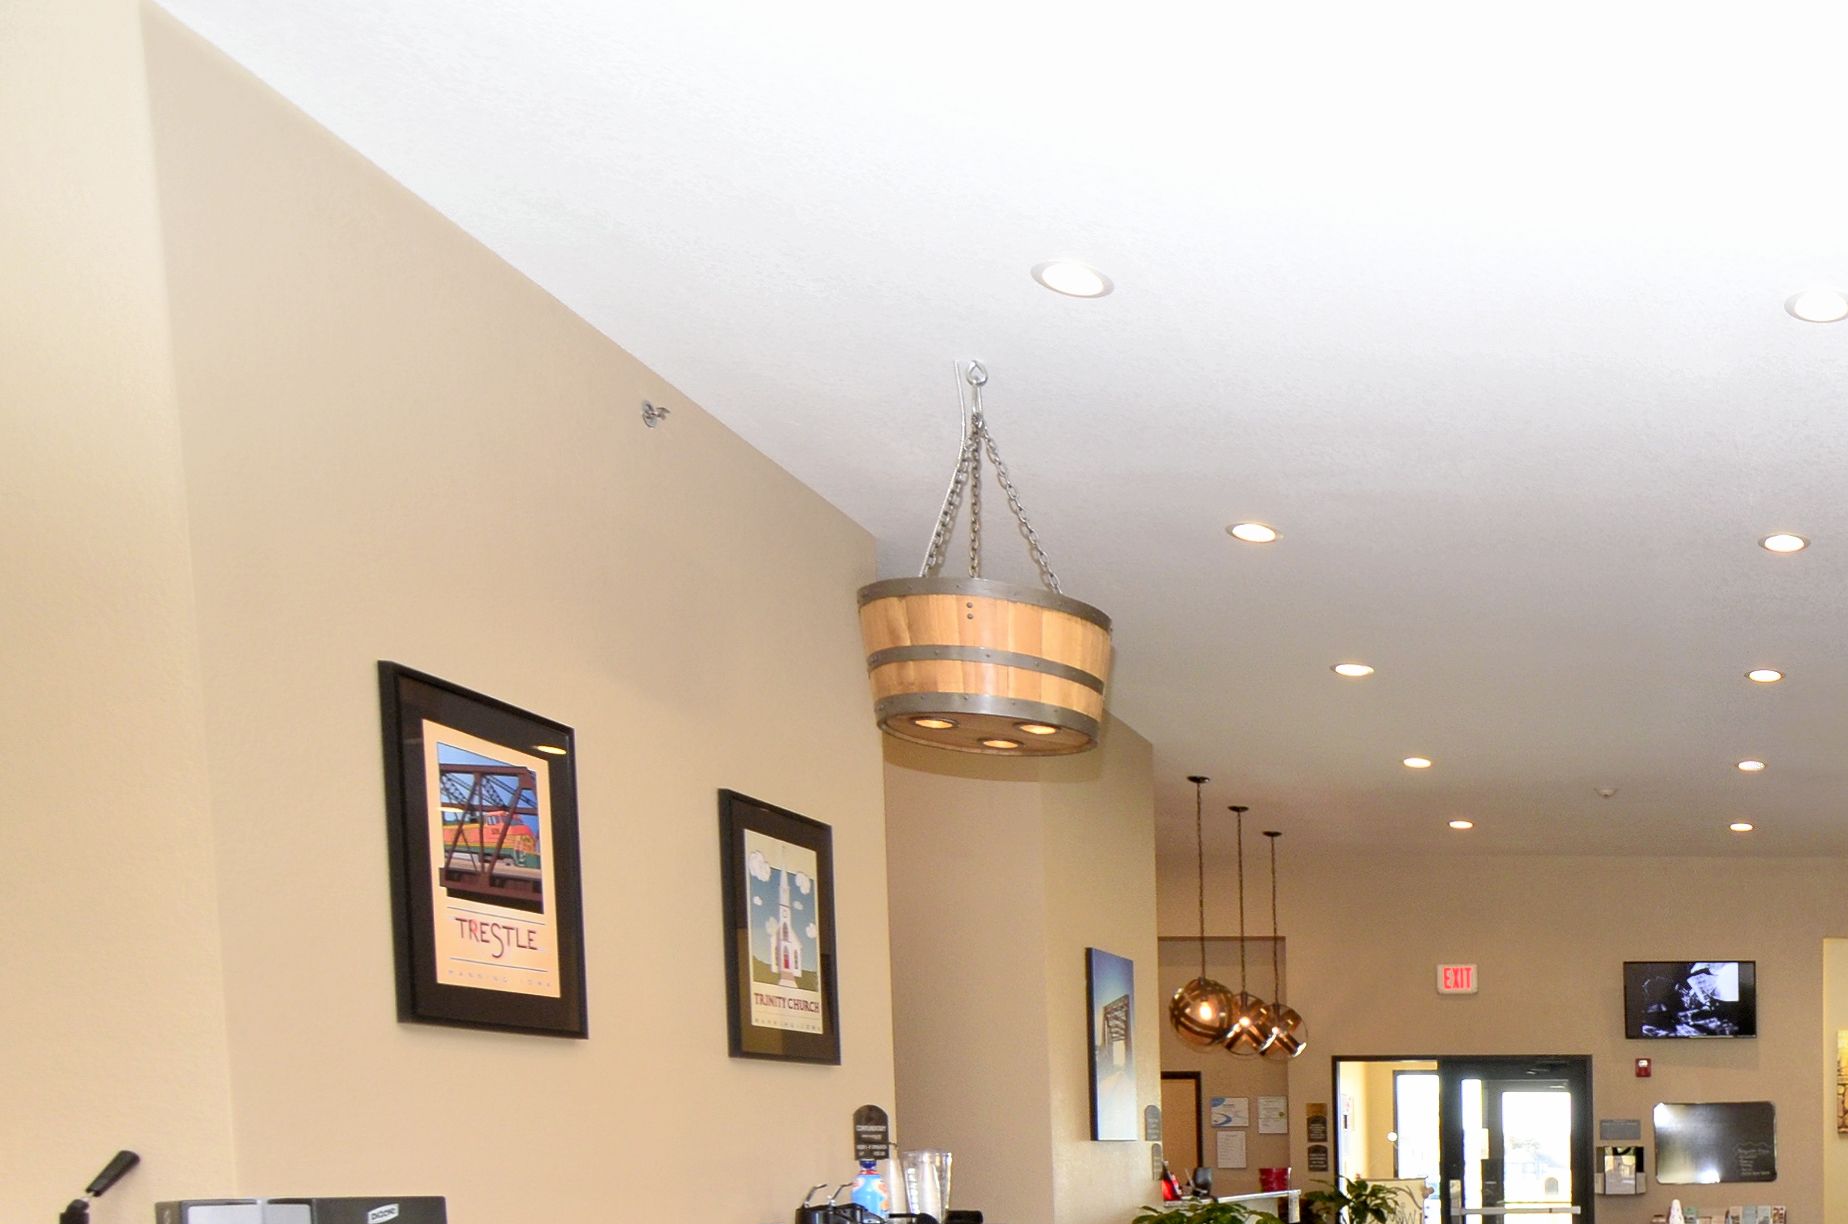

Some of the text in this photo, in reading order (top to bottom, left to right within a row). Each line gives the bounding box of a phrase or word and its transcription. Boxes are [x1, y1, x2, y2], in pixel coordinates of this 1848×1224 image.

[455, 917, 538, 958] TRESTLE
[1443, 967, 1473, 989] EXIT
[754, 992, 820, 1013] TRINITY CHURCH
